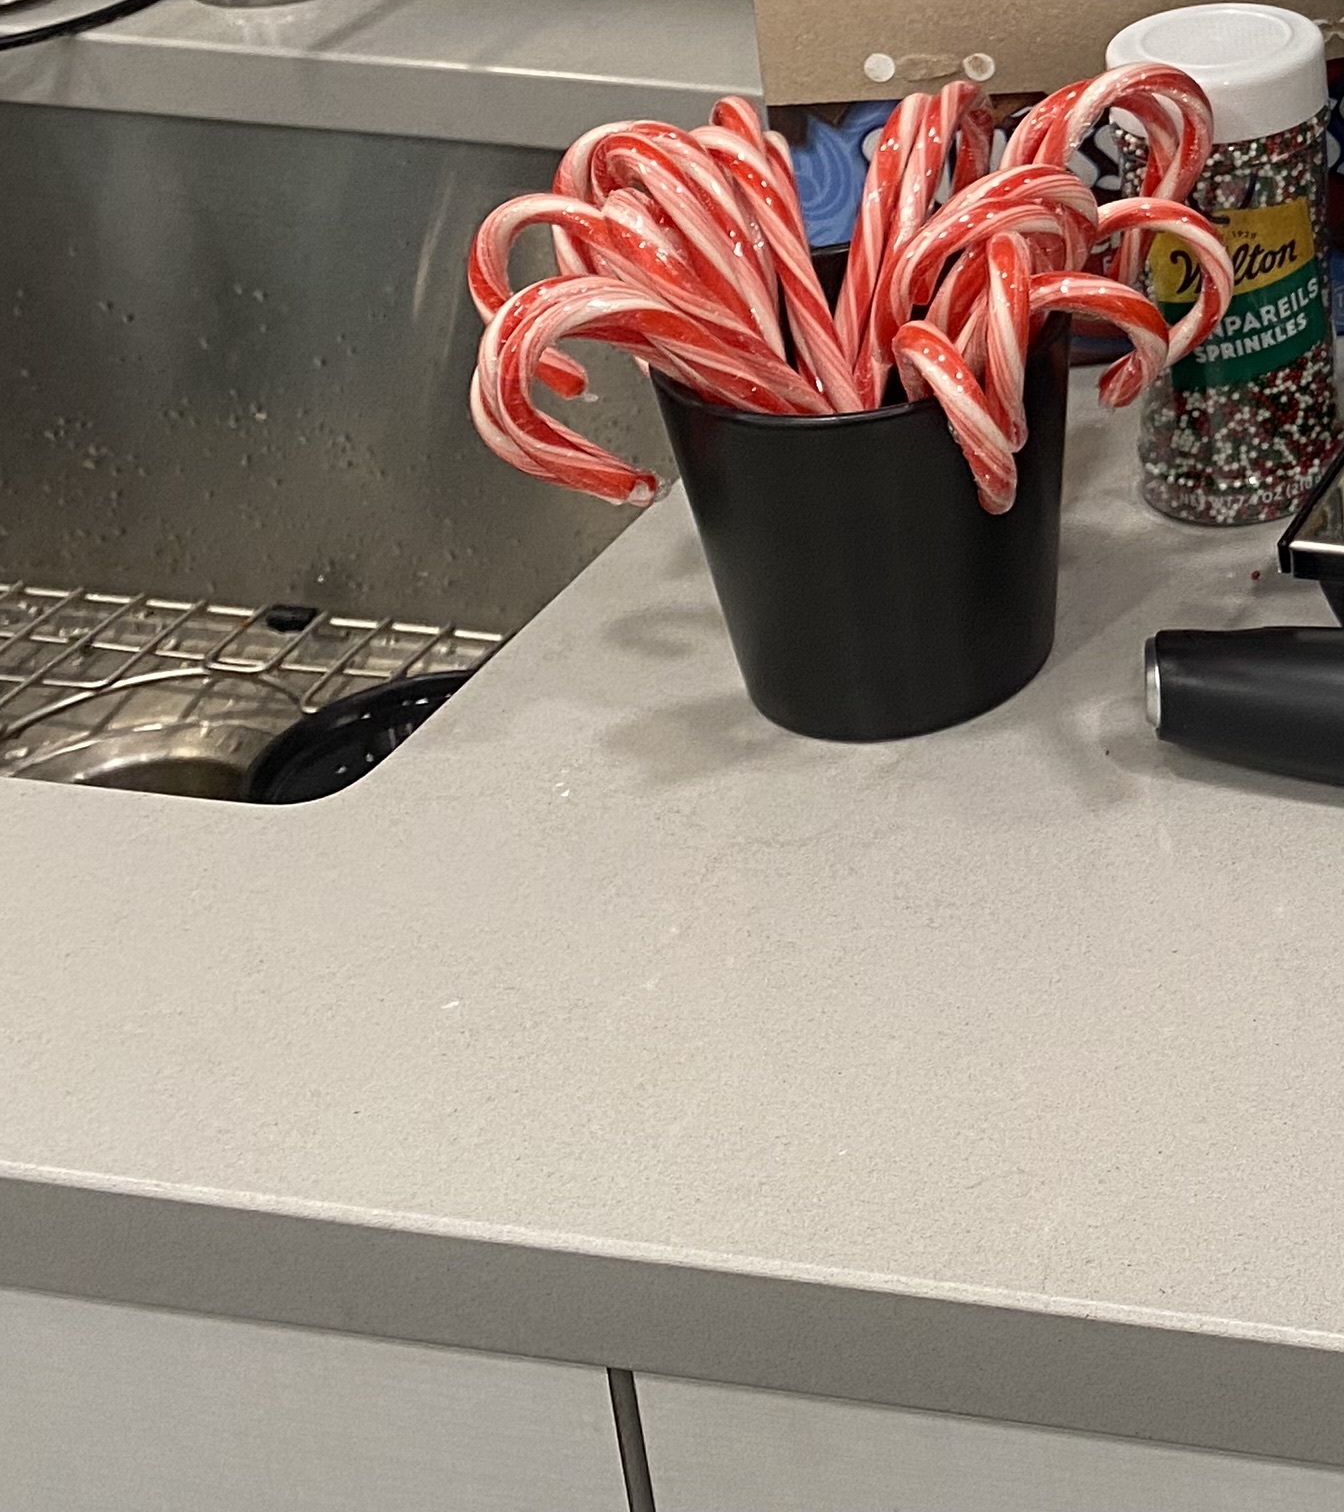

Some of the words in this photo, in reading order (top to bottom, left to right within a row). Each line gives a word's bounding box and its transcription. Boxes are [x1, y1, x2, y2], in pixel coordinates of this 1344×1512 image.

[1170, 239, 1298, 294] Wlton
[1208, 277, 1319, 341] NPAREILS
[1194, 313, 1308, 364] SPRINKLES
